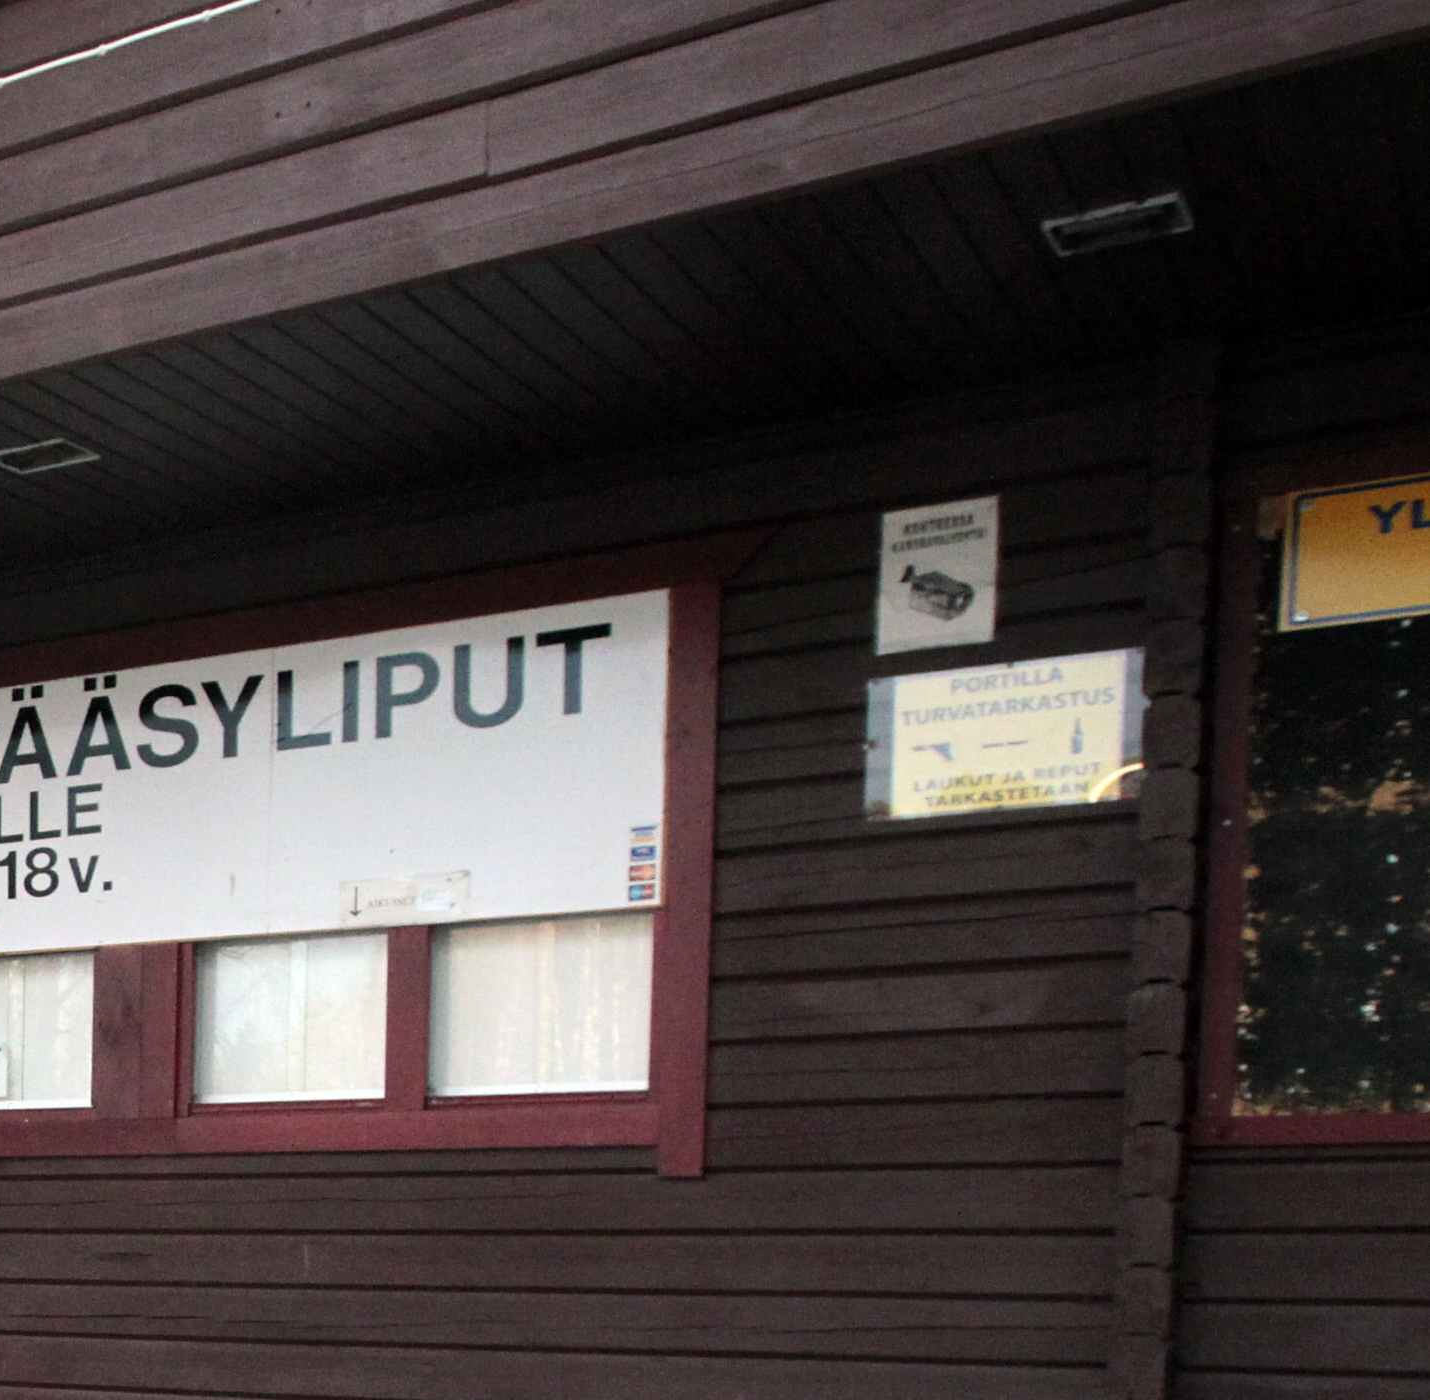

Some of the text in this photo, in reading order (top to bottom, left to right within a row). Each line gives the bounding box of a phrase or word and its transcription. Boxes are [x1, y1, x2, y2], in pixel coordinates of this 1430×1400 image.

[950, 666, 1064, 694] PORTILLA
[901, 687, 1118, 727] TURVATARKASTUS
[913, 772, 995, 793] LAUKUT
[1003, 770, 1026, 785] JA
[924, 781, 1090, 808] TARKASTETAAN
